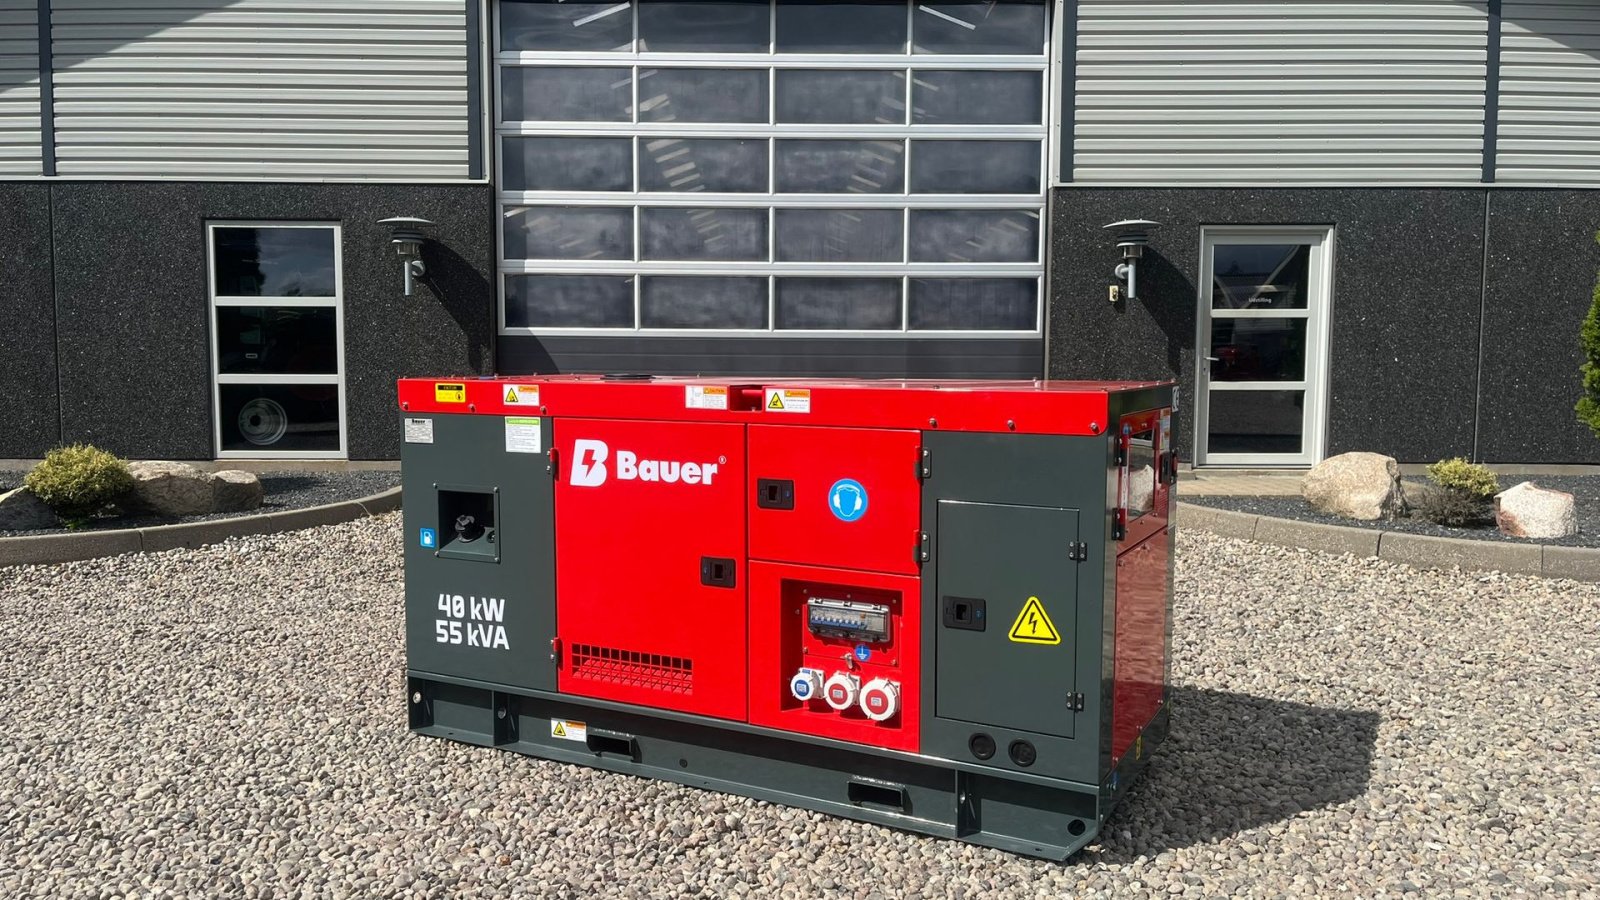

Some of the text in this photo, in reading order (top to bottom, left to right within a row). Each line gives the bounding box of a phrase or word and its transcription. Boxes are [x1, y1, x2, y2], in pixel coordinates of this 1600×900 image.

[438, 593, 505, 622] 40 kW
[436, 619, 510, 650] 55 kVA
